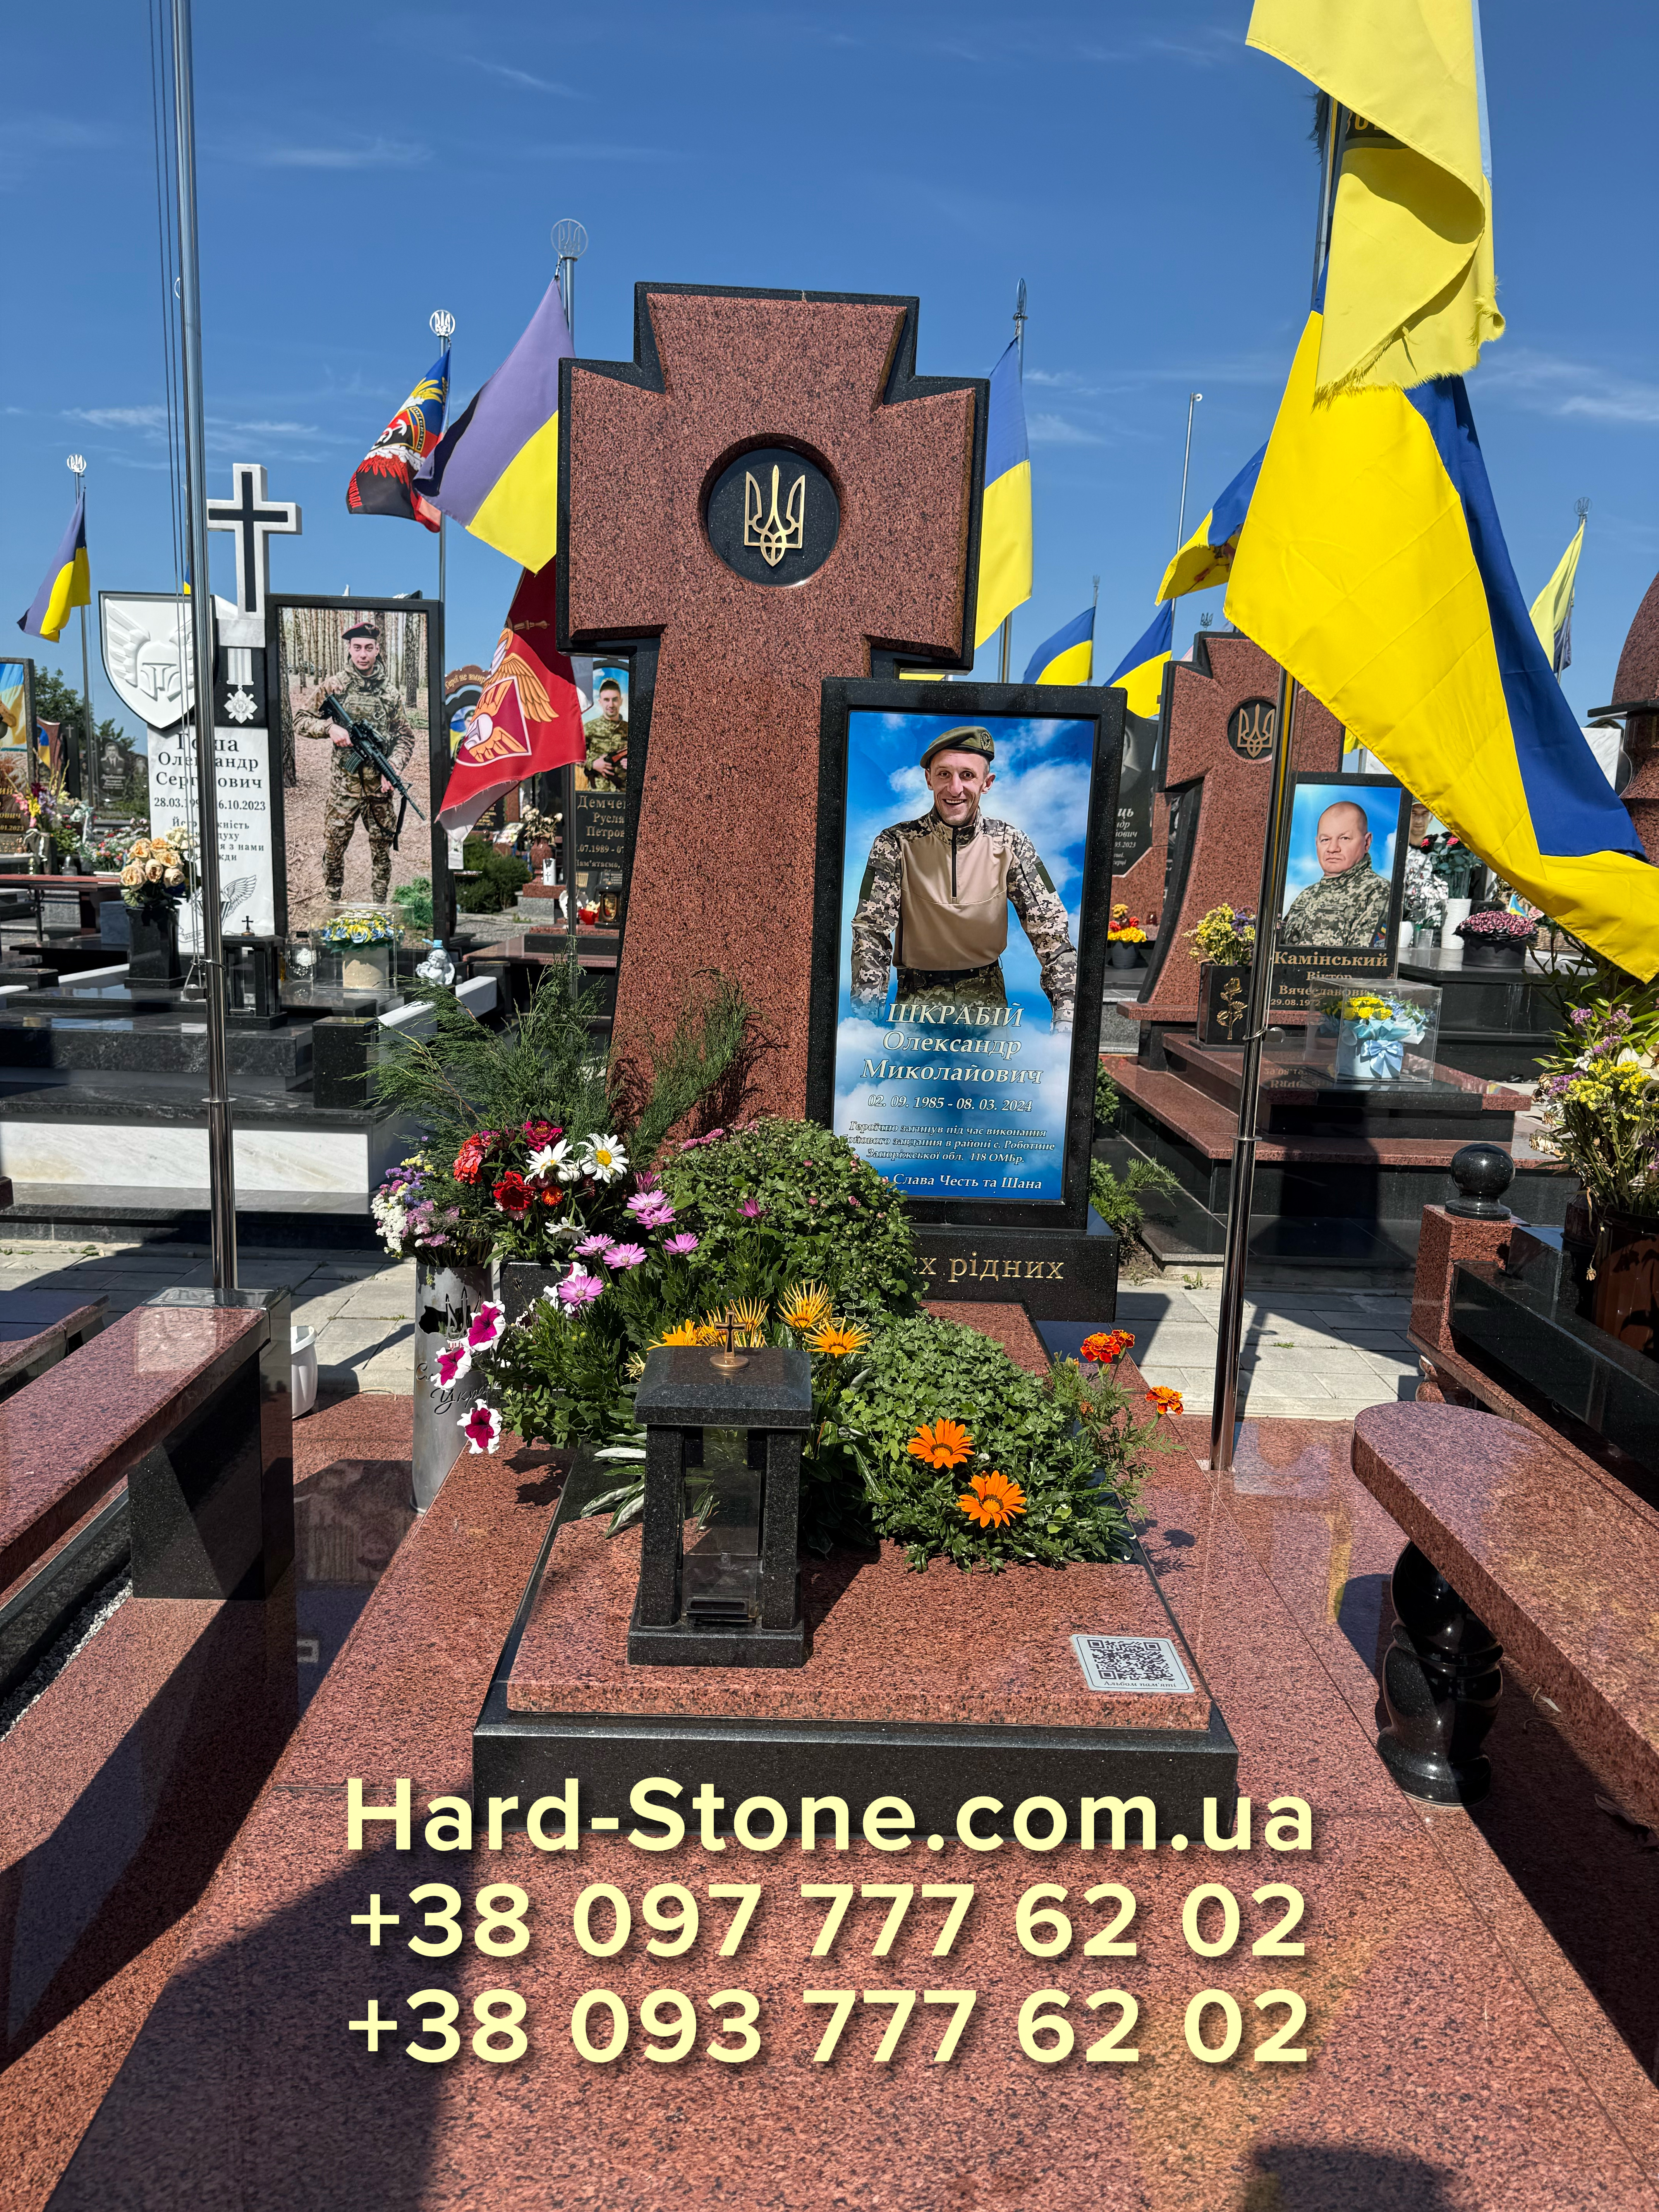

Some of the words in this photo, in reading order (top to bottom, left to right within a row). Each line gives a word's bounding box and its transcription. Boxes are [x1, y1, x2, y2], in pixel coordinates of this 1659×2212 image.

[158, 752, 259, 772] Олеандр
[156, 772, 262, 789] Сергович
[218, 800, 266, 811] 6.10.2023
[593, 812, 624, 826] Русла
[576, 844, 609, 853] .07.1989
[1274, 951, 1389, 967] Камінський
[885, 1002, 1025, 1027] ШКРАБІЙ
[883, 1030, 1022, 1060] Олександр
[860, 1058, 1044, 1084] Миколайович
[867, 1094, 886, 1107] 02.
[890, 1095, 909, 1108] 09.
[913, 1097, 945, 1109] 1985
[956, 1098, 975, 1110] 08.
[979, 1099, 998, 1111] 03.
[1001, 1099, 1033, 1112] 2024
[849, 1121, 899, 1133] Героїчно
[900, 1124, 943, 1136] загинув
[946, 1125, 963, 1135] під
[986, 1128, 1047, 1137] виконання
[893, 1137, 943, 1147] завдання
[953, 1139, 992, 1150] районі
[1004, 1140, 1055, 1151] Роботине
[866, 1148, 941, 1161] Запоріжської
[942, 1151, 964, 1161] обл.
[970, 1152, 987, 1161] 118
[989, 1153, 1025, 1165] ОМБр.
[893, 1173, 935, 1185] Слава
[940, 1175, 979, 1187] Честь
[982, 1179, 997, 1188] та
[1000, 1176, 1042, 1189] Шана
[948, 1250, 1064, 1283] рідних
